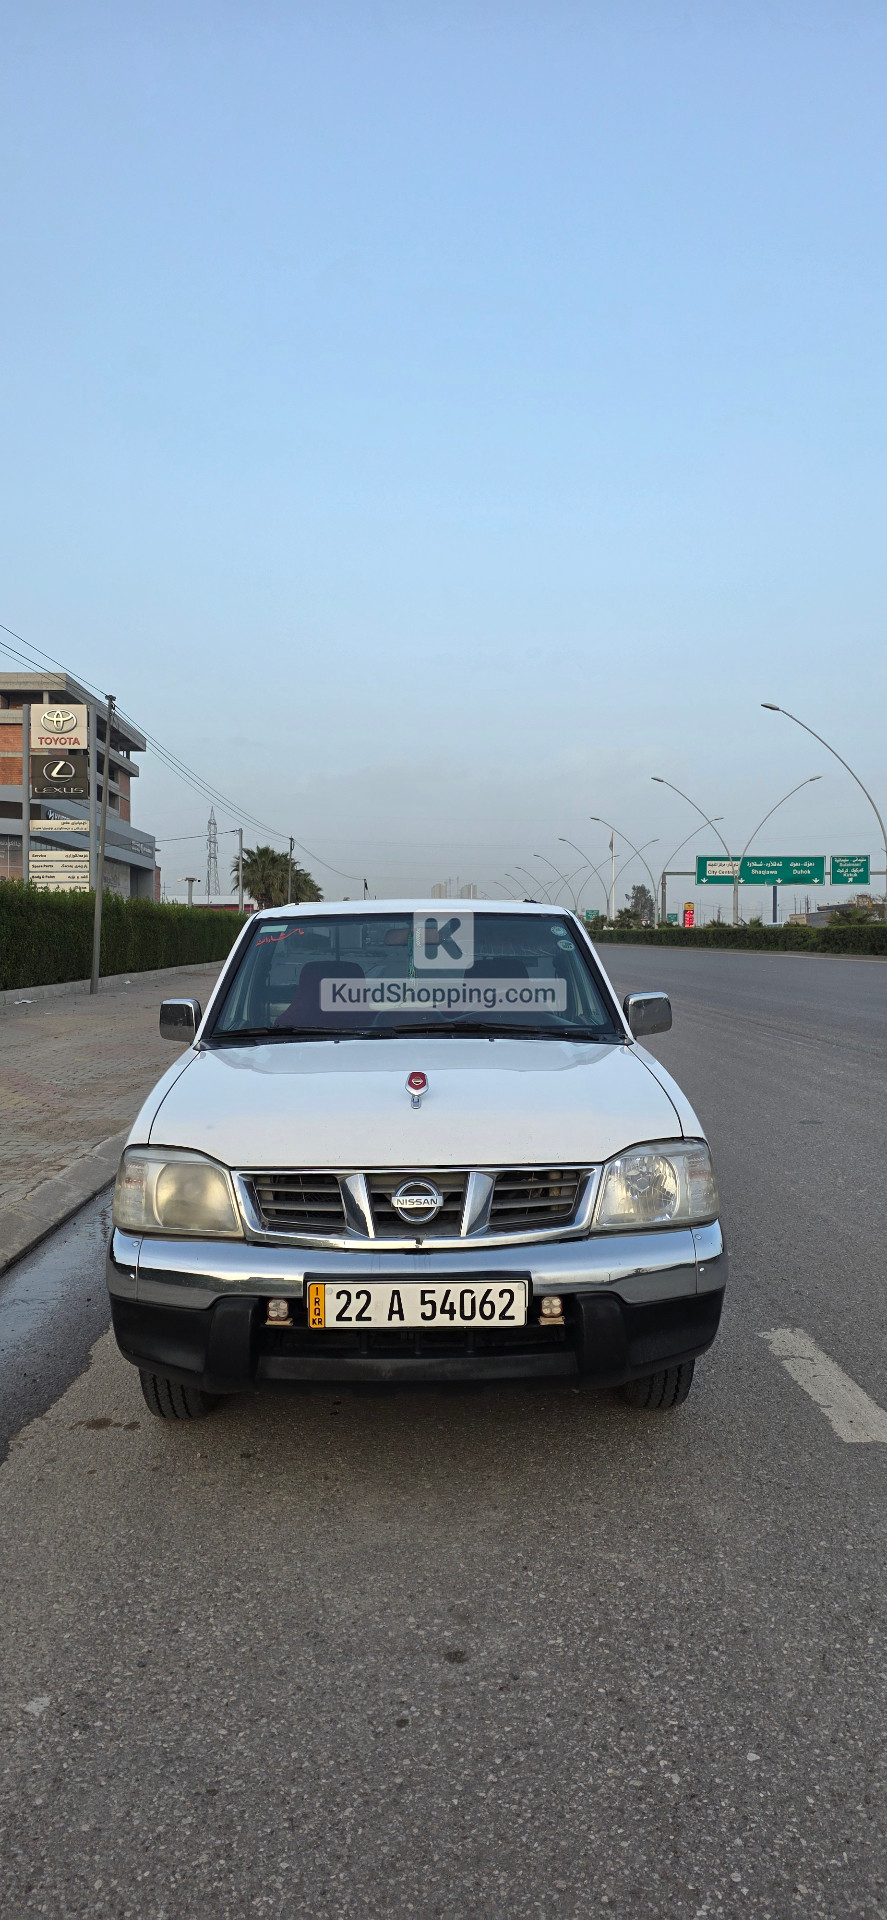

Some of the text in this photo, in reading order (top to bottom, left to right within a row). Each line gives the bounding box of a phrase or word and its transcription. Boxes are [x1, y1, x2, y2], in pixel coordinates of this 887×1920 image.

[38, 736, 81, 745] TOYOTA
[35, 786, 84, 794] LEXUS
[396, 1198, 438, 1206] NISSAN
[335, 1288, 515, 1322] 22 A 54062
[312, 1318, 323, 1326] KR
